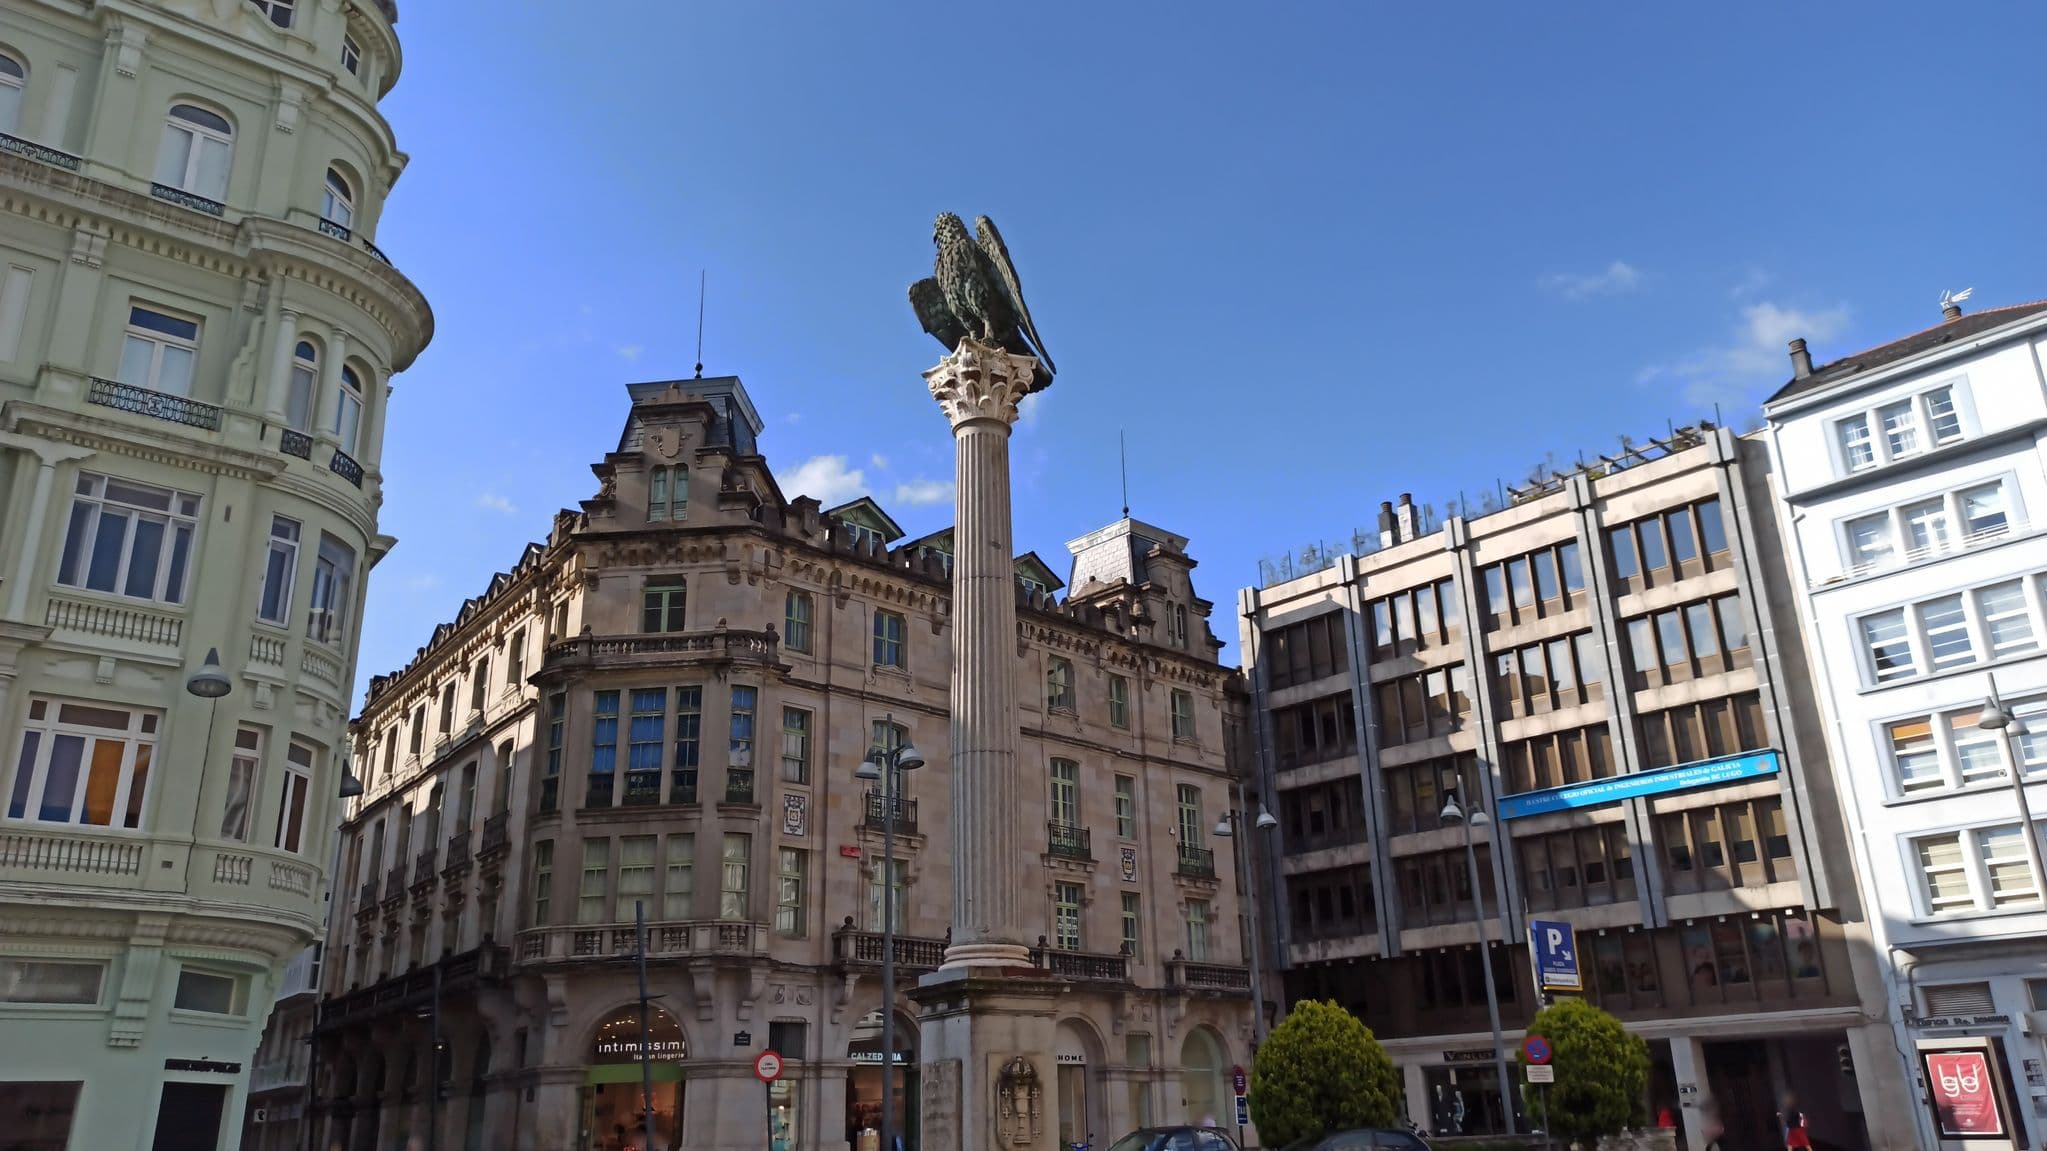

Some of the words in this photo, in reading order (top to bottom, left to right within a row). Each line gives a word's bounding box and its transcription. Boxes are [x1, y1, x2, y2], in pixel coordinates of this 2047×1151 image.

[1711, 762, 1741, 773] GALICIA
[1546, 928, 1562, 955] P
[851, 1052, 902, 1062] CALZEDIA
